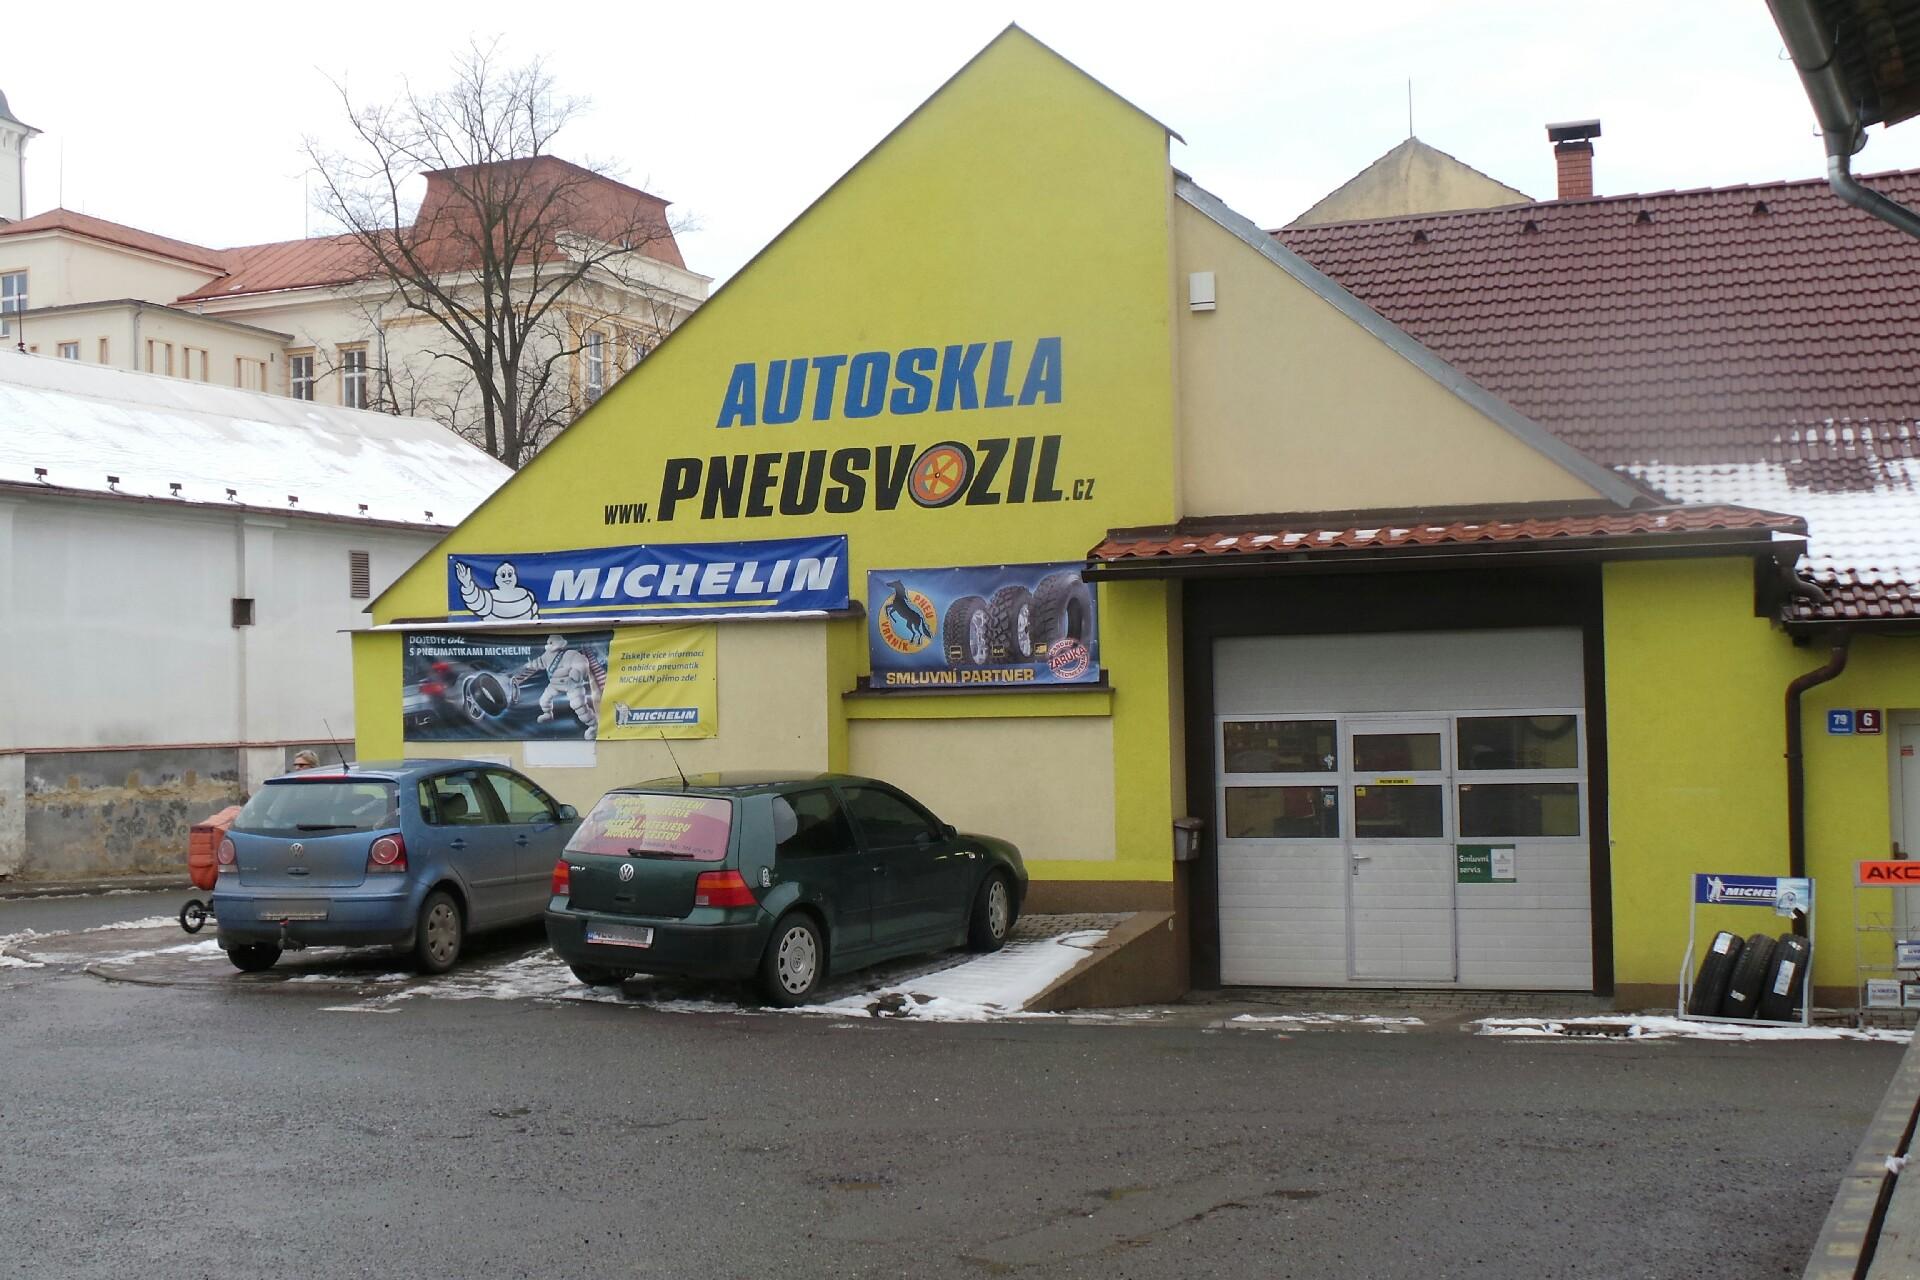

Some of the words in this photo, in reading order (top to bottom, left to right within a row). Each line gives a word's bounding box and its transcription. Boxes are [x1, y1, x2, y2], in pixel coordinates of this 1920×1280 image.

[716, 337, 1062, 428] AUTOSKLA
[547, 556, 838, 602] MICHELIN
[913, 594, 934, 619] PNEU
[409, 647, 415, 656] S
[416, 647, 483, 656] PNEUMATIKAMI
[620, 652, 650, 661] Získejte
[657, 662, 699, 672] pneumatik
[619, 675, 655, 684] MICHELIN
[681, 674, 697, 682] zde!
[961, 668, 1034, 683] PARTNER
[632, 710, 696, 721] MICHELIN
[1833, 714, 1848, 725] 79
[1863, 712, 1873, 726] 6
